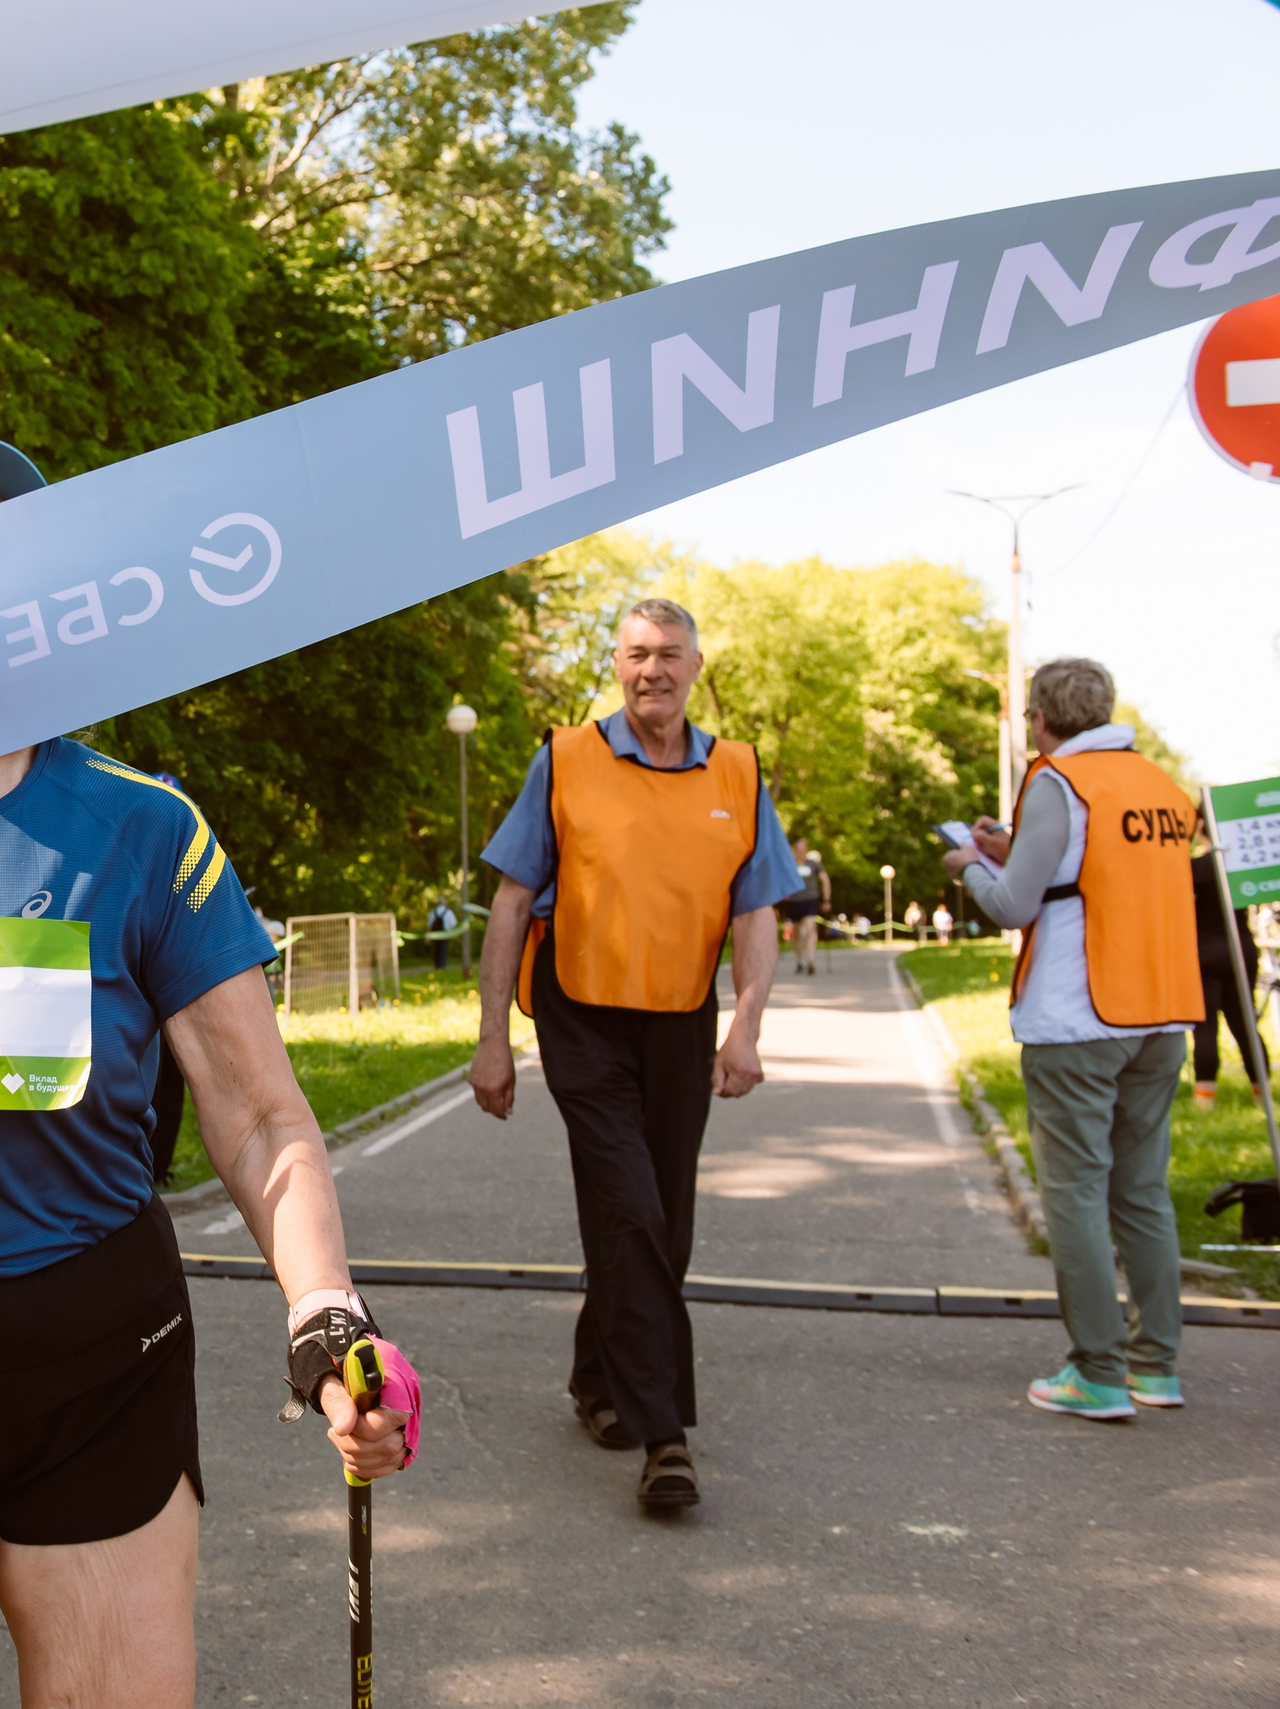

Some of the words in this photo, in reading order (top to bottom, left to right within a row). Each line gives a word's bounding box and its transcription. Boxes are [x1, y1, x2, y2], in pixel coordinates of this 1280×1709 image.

[1122, 808, 1187, 847] СУДЬ
[29, 1074, 57, 1084] Вклад
[151, 1312, 183, 1344] DEMIX
